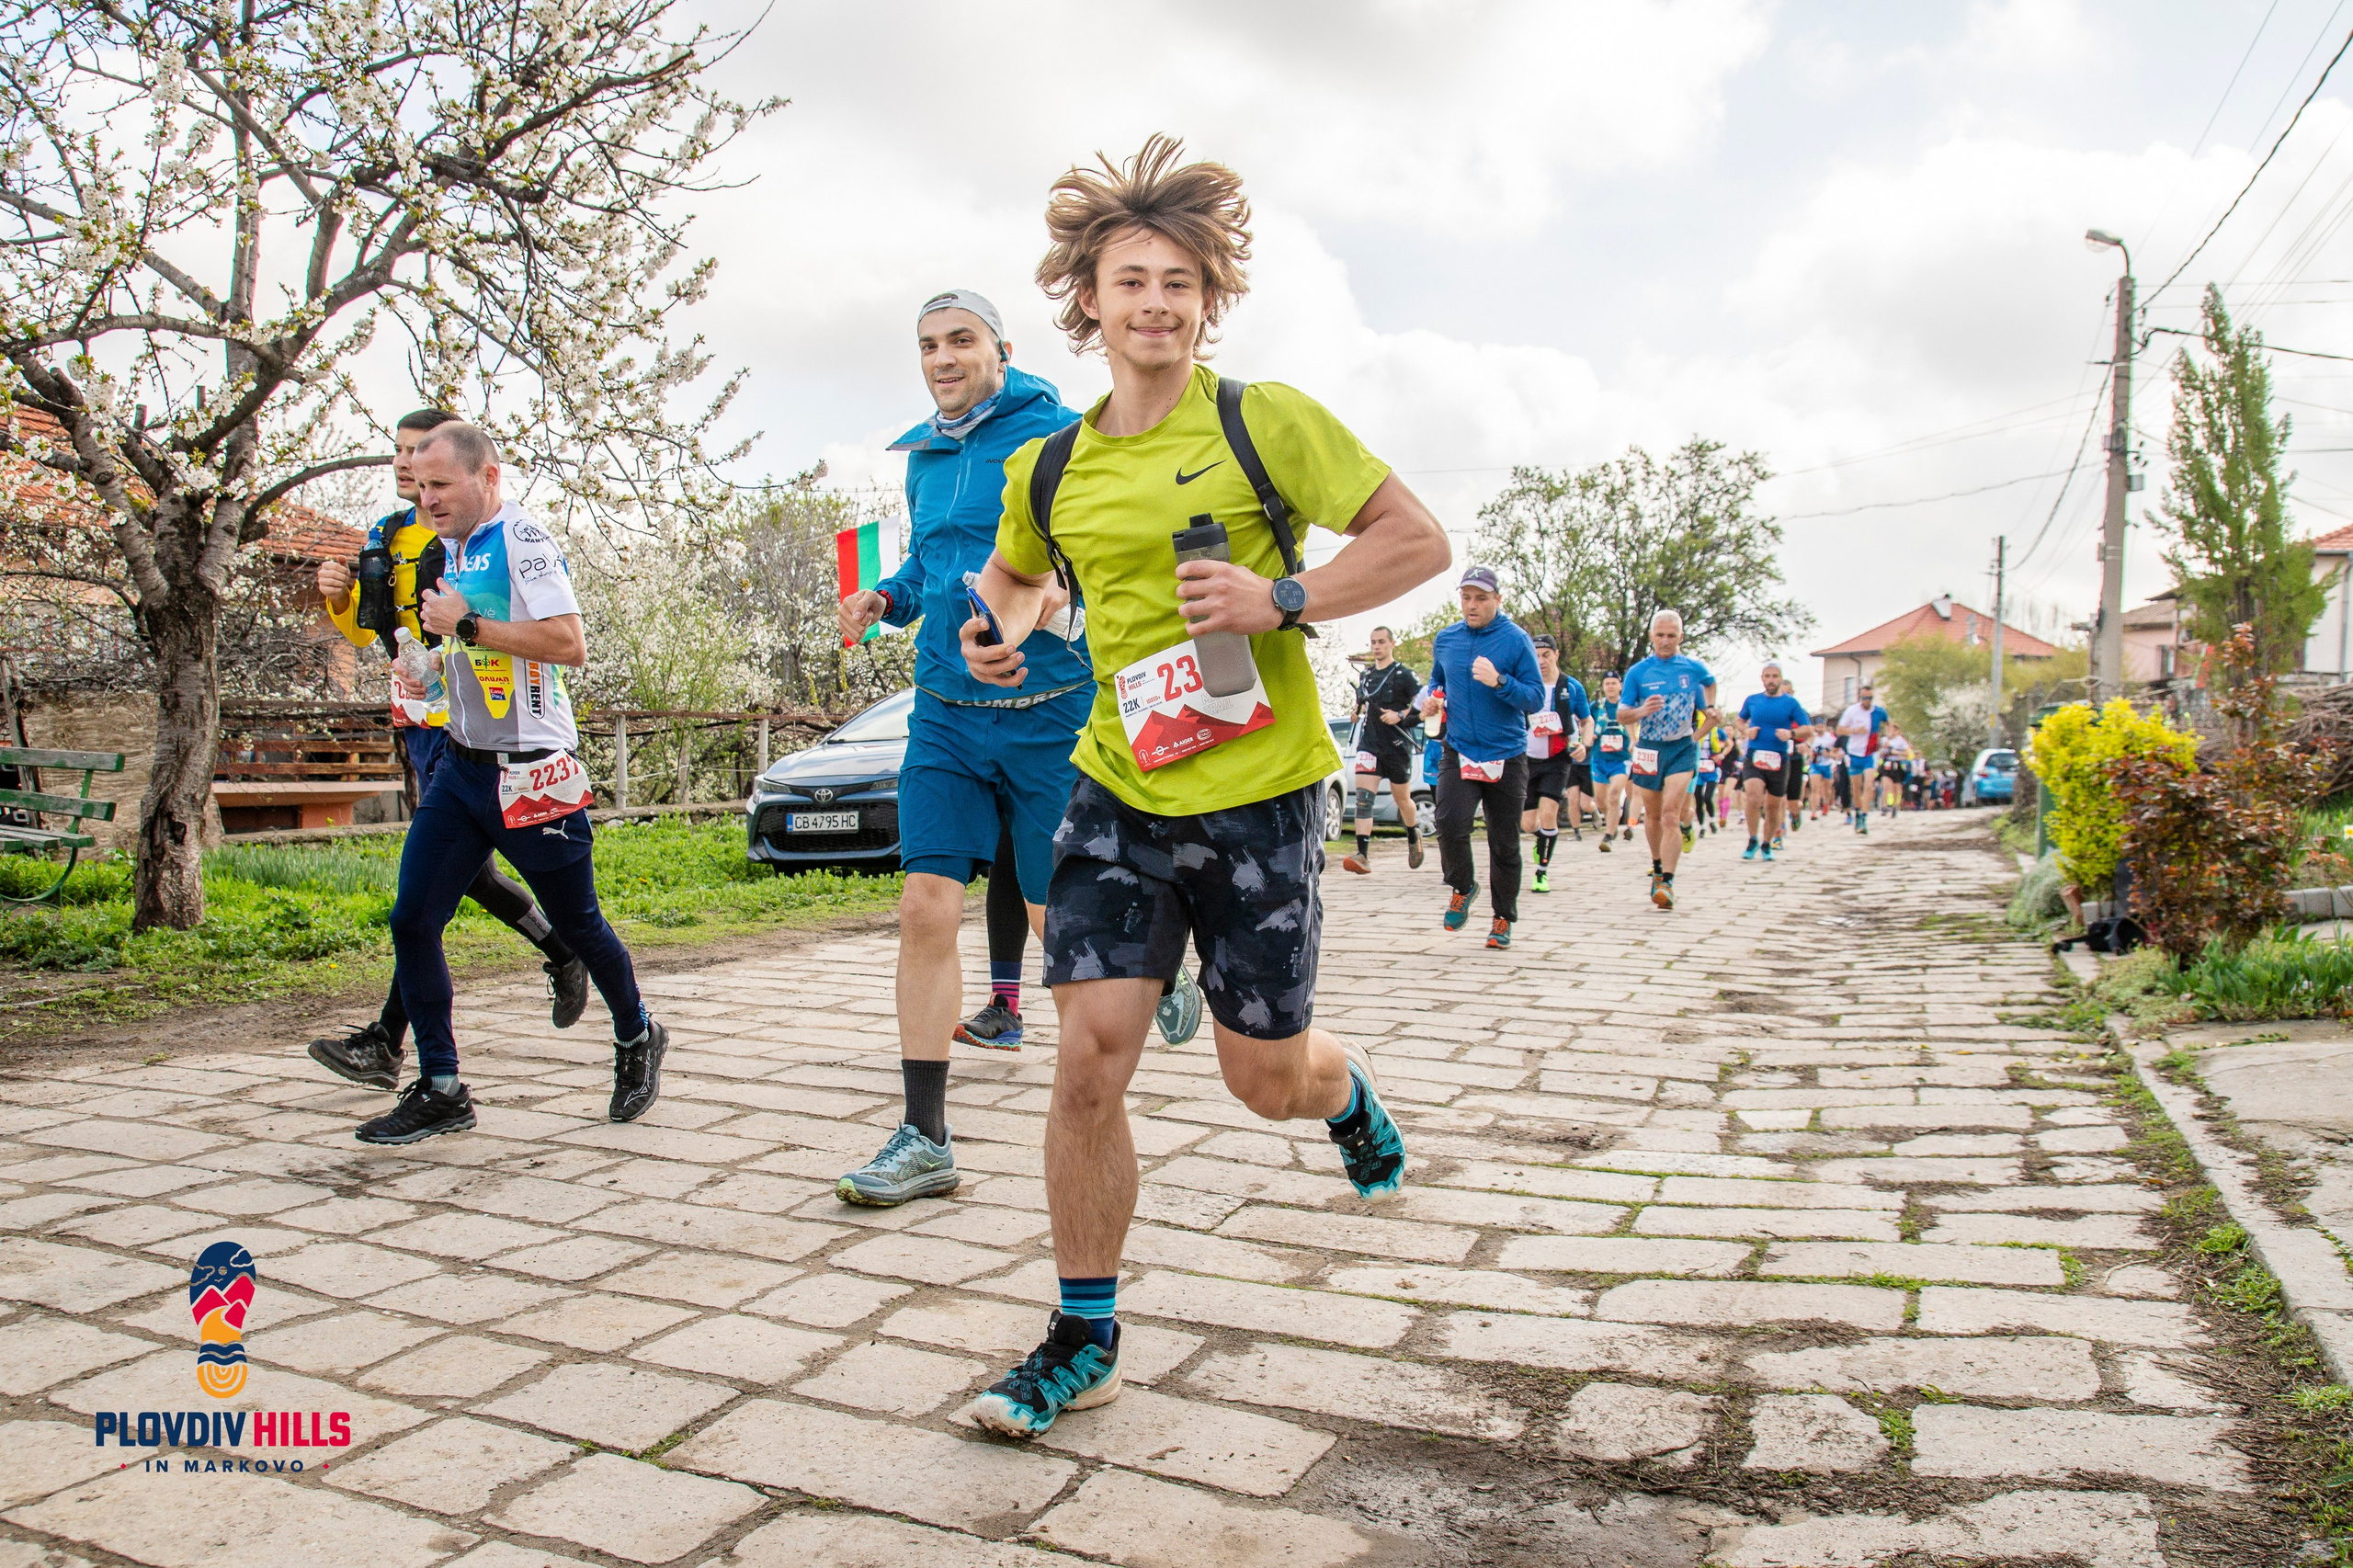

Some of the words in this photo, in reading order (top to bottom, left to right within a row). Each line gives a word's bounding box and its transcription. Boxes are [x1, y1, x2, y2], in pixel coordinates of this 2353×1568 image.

[1123, 698, 1141, 713] 22K
[1637, 751, 1655, 763] 2310
[795, 816, 810, 829] CB
[812, 815, 839, 829] 4795
[842, 814, 856, 828] HC
